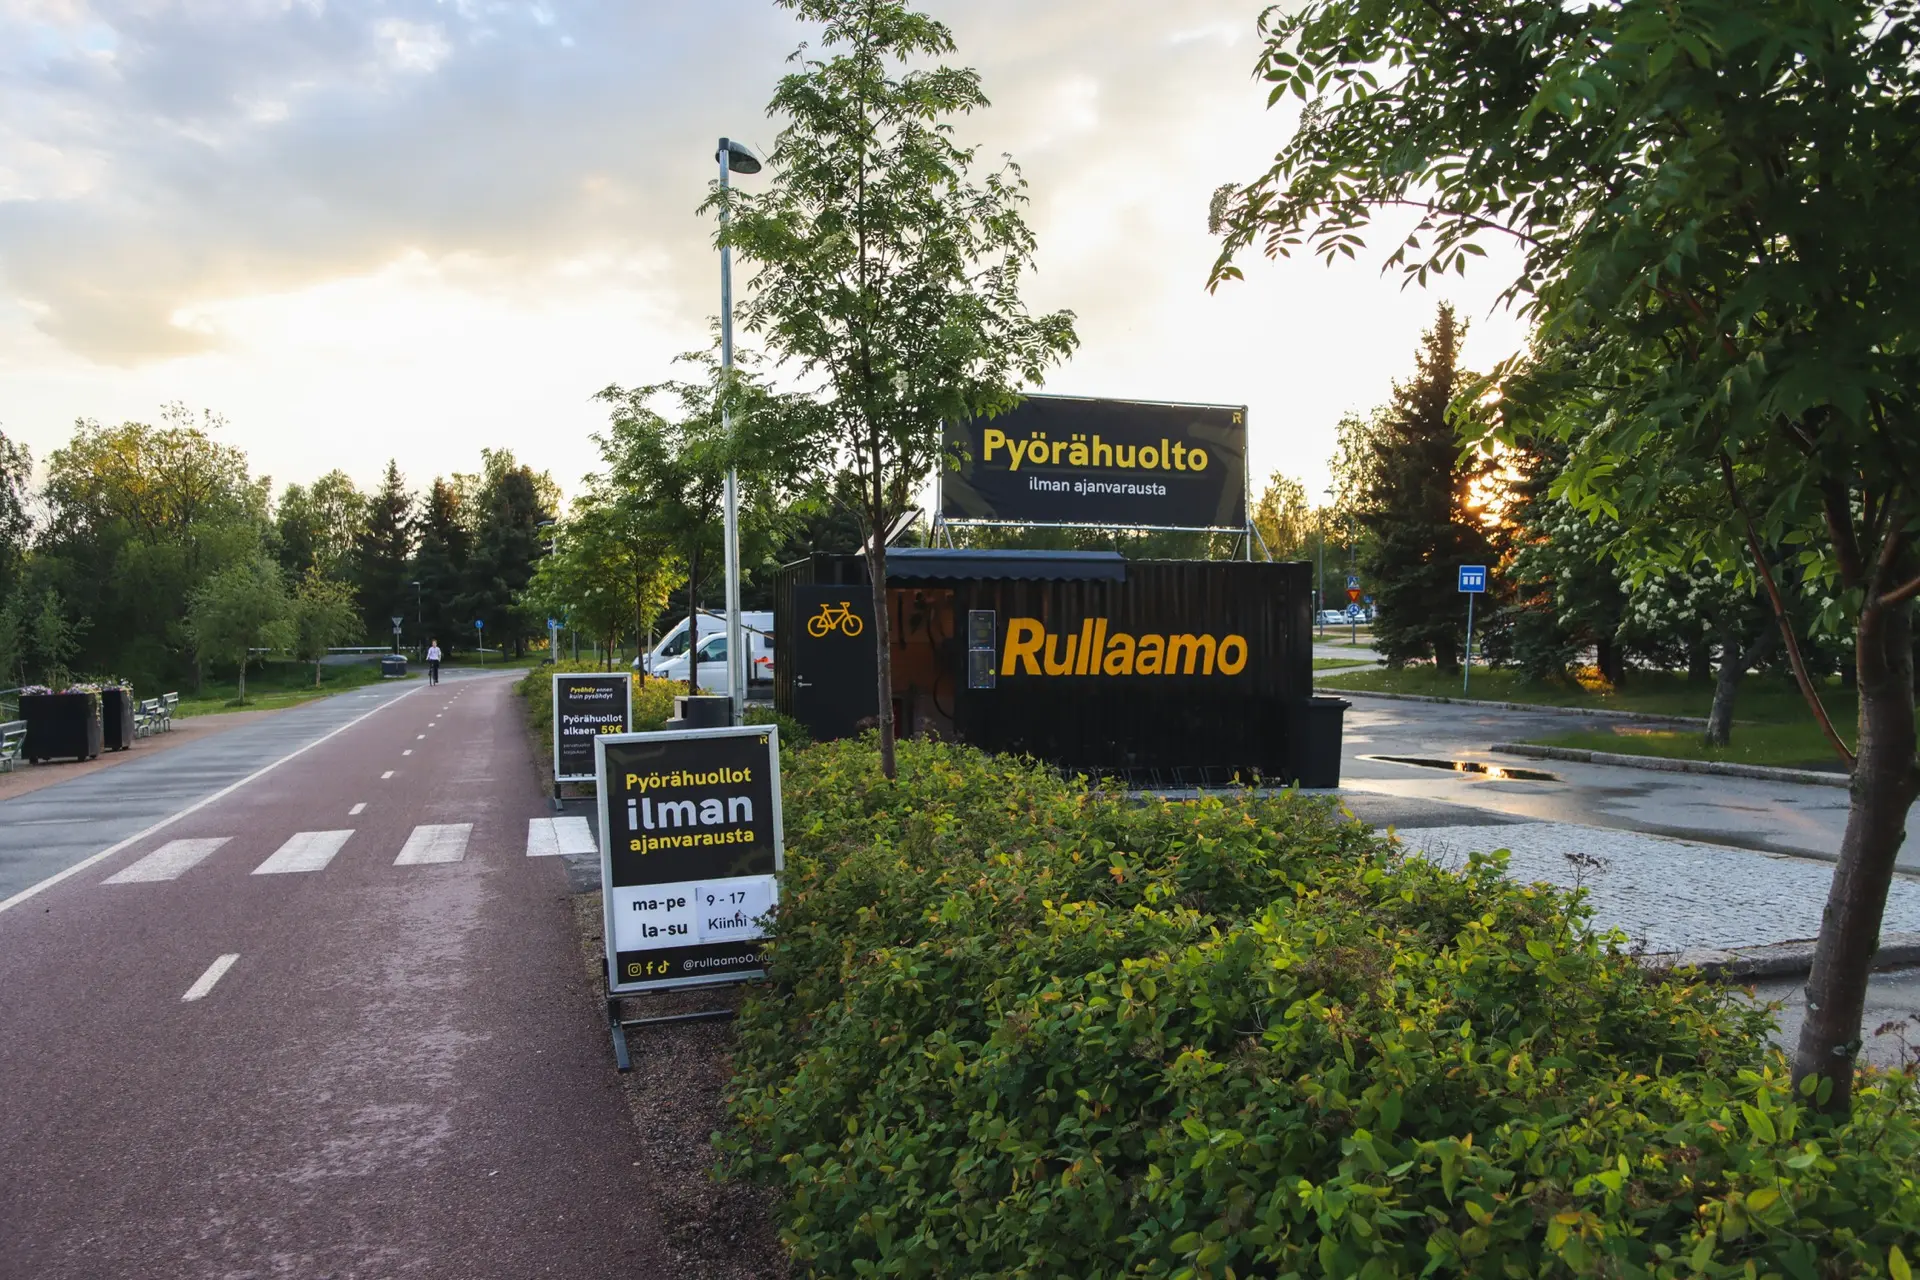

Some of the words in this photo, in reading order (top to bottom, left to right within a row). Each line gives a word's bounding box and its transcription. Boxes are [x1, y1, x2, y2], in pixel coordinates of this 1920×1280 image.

[983, 429, 1209, 472] Pyörähuolto
[1029, 476, 1070, 492] ilman
[1074, 477, 1167, 496] ajanvarausta
[1001, 617, 1248, 676] Rullaamo
[563, 714, 623, 725] Pyörähuollot
[563, 726, 596, 735] alkaen
[601, 725, 623, 734] 59€
[625, 767, 752, 794] Pyörähuollot
[627, 796, 754, 831] ilman
[629, 828, 755, 855] ajanvarausta
[632, 897, 687, 912] ma-pe
[706, 894, 715, 906] 9
[729, 891, 746, 905] 17
[642, 923, 688, 938] la-su
